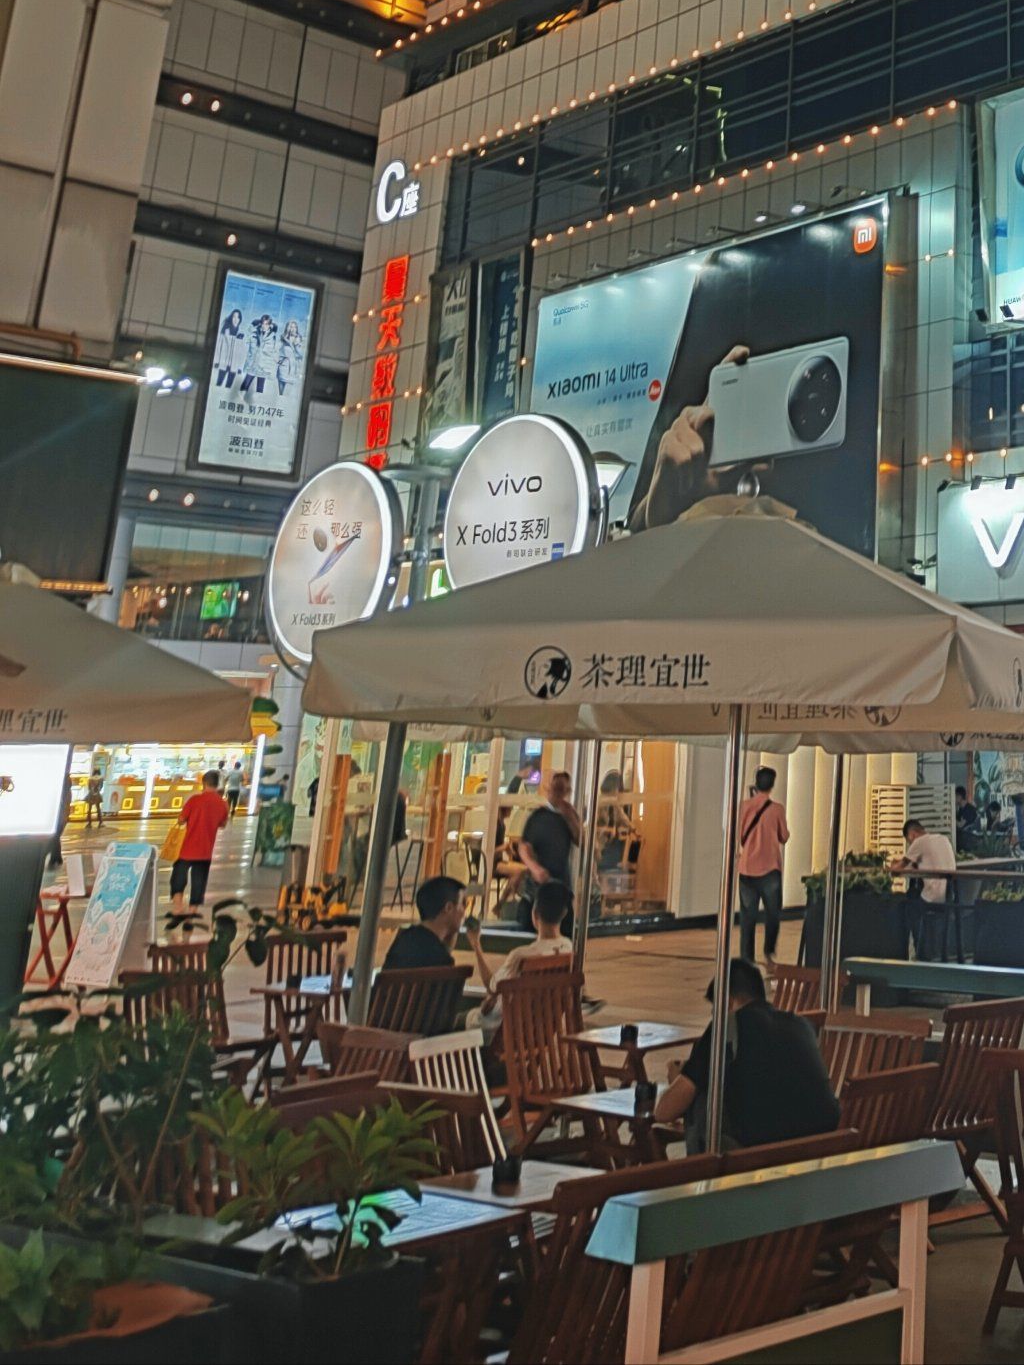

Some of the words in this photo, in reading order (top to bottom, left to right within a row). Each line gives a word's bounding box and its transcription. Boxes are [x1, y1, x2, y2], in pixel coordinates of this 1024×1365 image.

[604, 367, 616, 385] 14
[619, 361, 649, 383] Ultra
[229, 435, 265, 450] 波司登
[487, 473, 543, 497] vivo
[301, 499, 336, 516] 这么轻
[456, 525, 469, 546] X
[472, 516, 550, 545] Fold3系列
[578, 652, 711, 690] 茶理宜世
